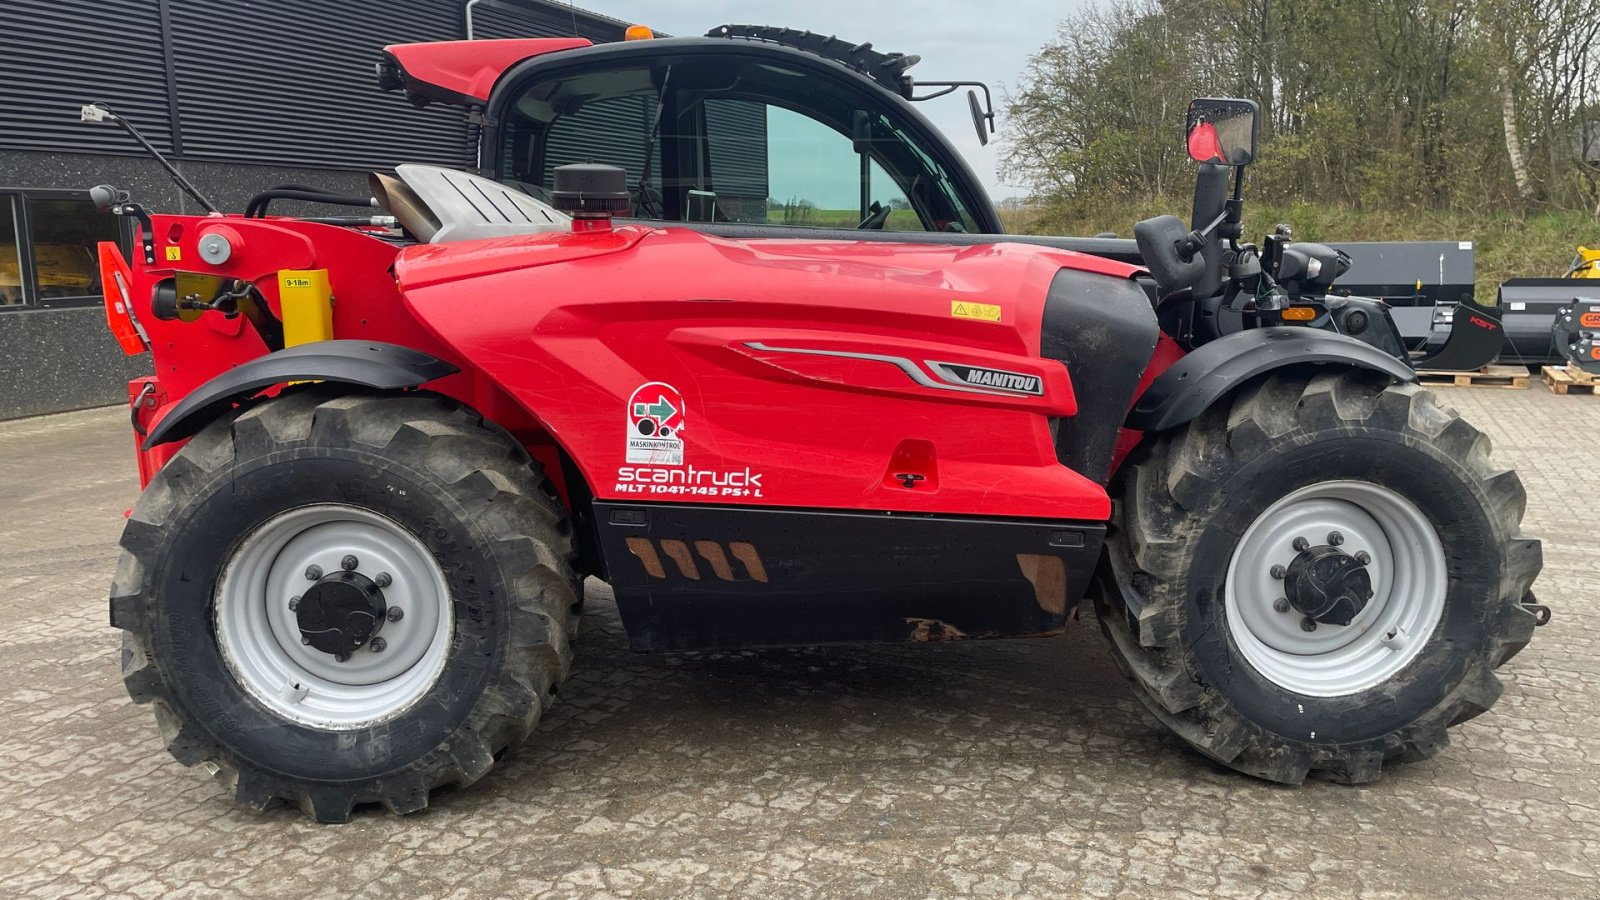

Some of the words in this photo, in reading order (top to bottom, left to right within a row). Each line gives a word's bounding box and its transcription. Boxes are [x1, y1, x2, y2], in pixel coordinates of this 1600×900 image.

[286, 279, 309, 287] 9-18m
[966, 369, 1036, 391] MANITOU
[629, 440, 681, 450] MASKINKONTROL
[617, 464, 763, 487] scantruck
[615, 483, 646, 493] MLT
[649, 484, 719, 495] 1041-145
[721, 486, 751, 496] PS+
[754, 488, 764, 497] L
